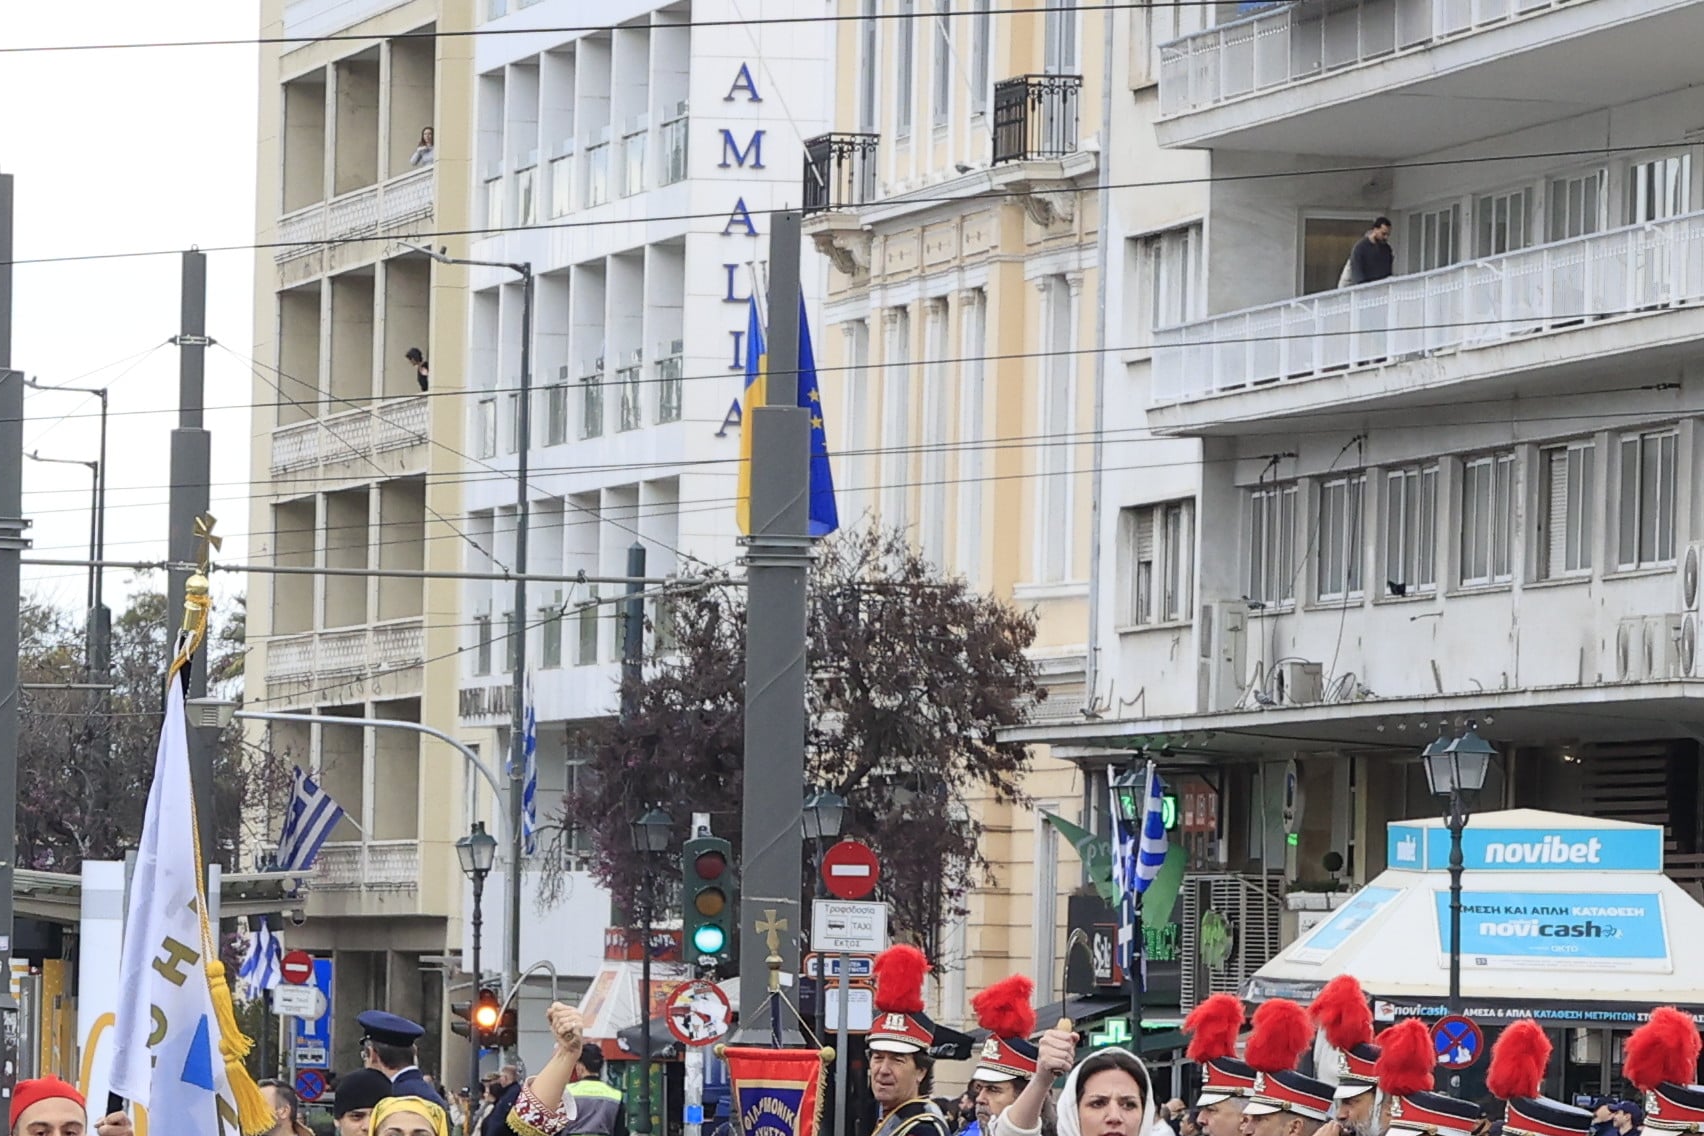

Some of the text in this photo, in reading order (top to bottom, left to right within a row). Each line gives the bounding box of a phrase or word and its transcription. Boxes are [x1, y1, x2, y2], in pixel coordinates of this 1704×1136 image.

[714, 61, 766, 438] AMALIA
[1485, 835, 1601, 864] novibet
[1504, 906, 1527, 915] ΚΑΙ
[1532, 907, 1569, 916] ΑΠΛΗ
[1479, 919, 1602, 938] novicash
[1394, 1004, 1448, 1016] novicash
[1463, 1008, 1495, 1017] ΑΜΕΣΑ
[1505, 1009, 1532, 1018] ΑΠΛΑ
[1533, 1010, 1583, 1020] ΚΑΤΑΘΕΣΗ
[1584, 1011, 1636, 1021] ΜΕΤΡΗΤΩΝ
